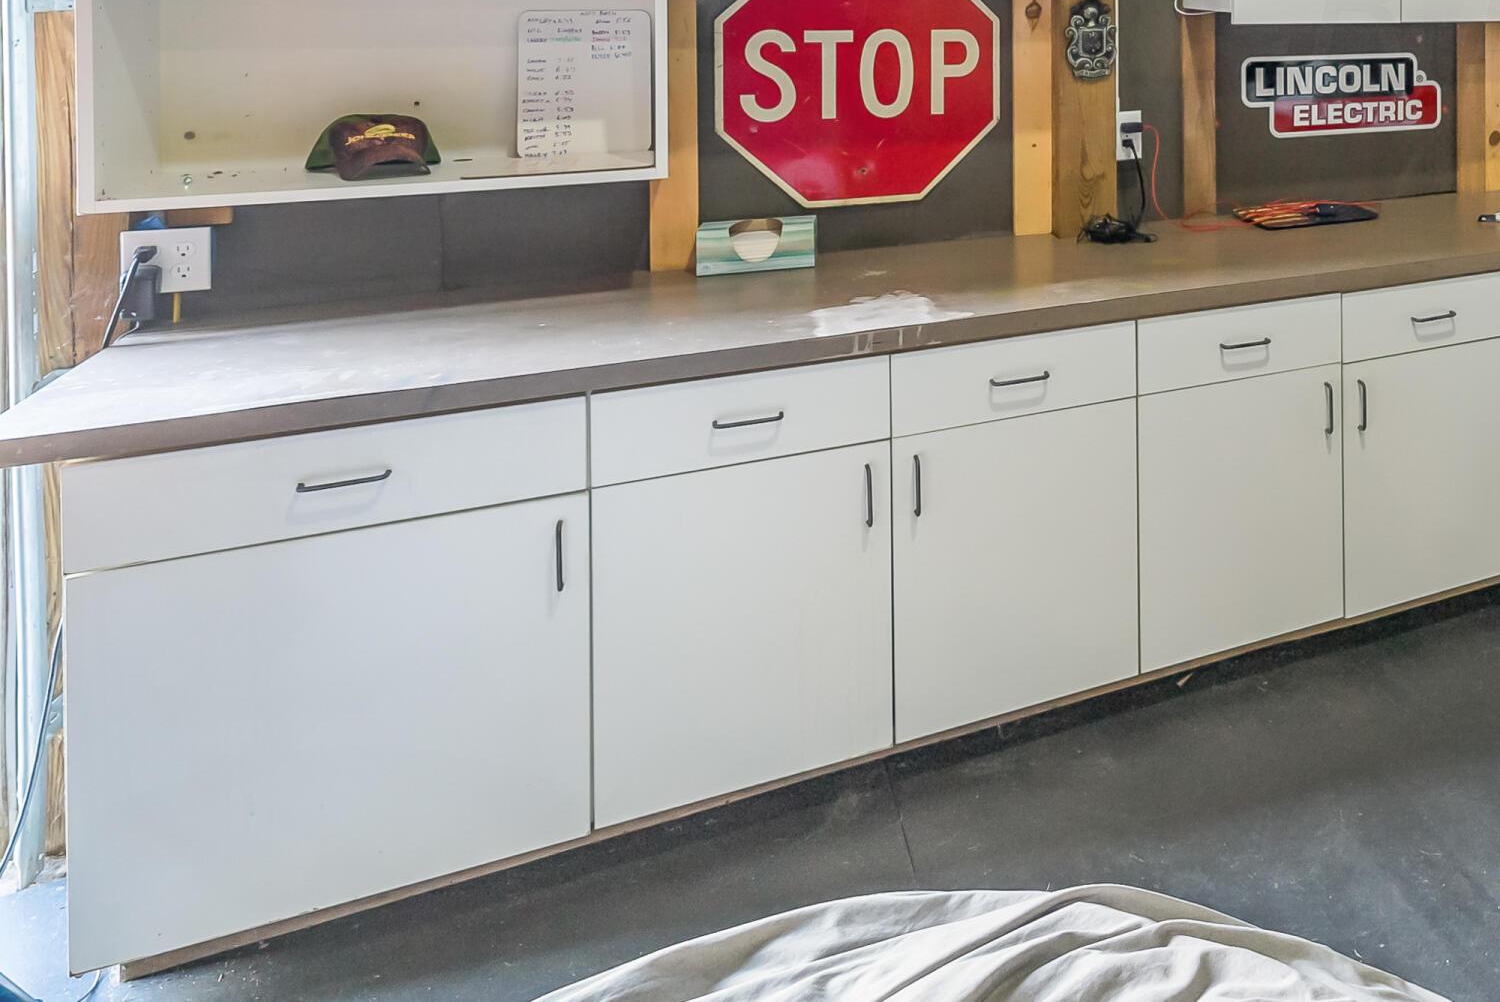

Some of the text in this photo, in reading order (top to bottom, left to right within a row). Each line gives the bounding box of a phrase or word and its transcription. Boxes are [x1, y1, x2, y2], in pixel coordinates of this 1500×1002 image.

[739, 27, 980, 123] STOP
[1255, 62, 1406, 97] LINCOLN
[1293, 99, 1423, 127] ELECTRIC
